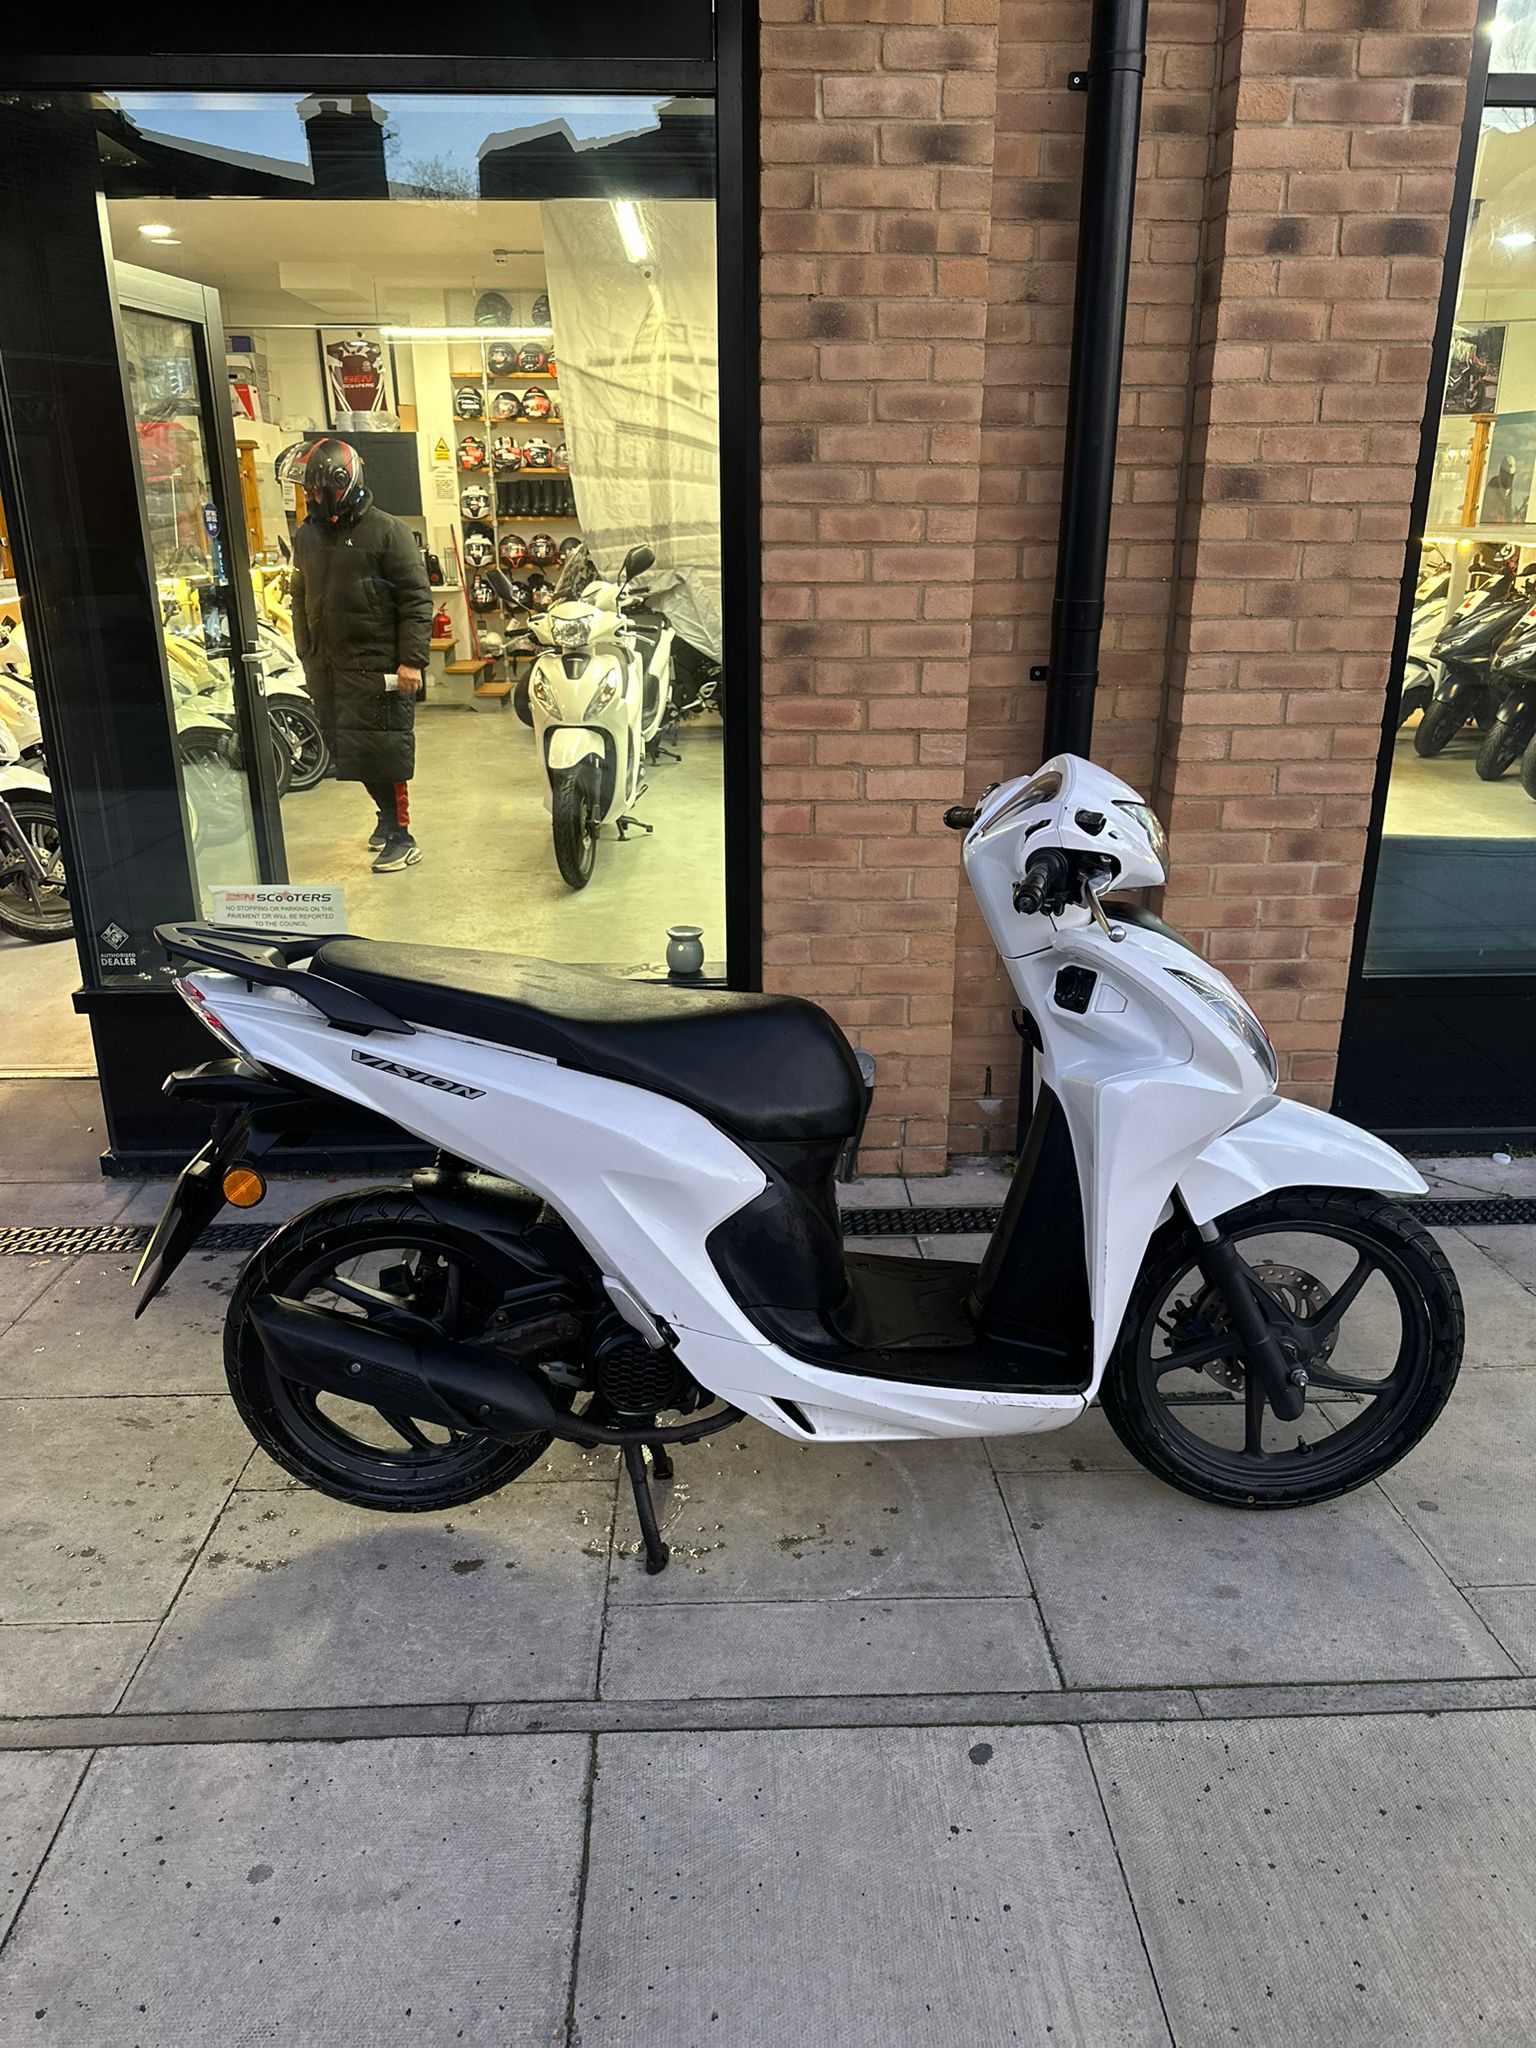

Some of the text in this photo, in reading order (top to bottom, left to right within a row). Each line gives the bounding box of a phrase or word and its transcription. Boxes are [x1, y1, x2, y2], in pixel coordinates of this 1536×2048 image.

[217, 544, 225, 573] PULL
[100, 957, 137, 966] DEALER
[352, 1050, 485, 1099] VISION
